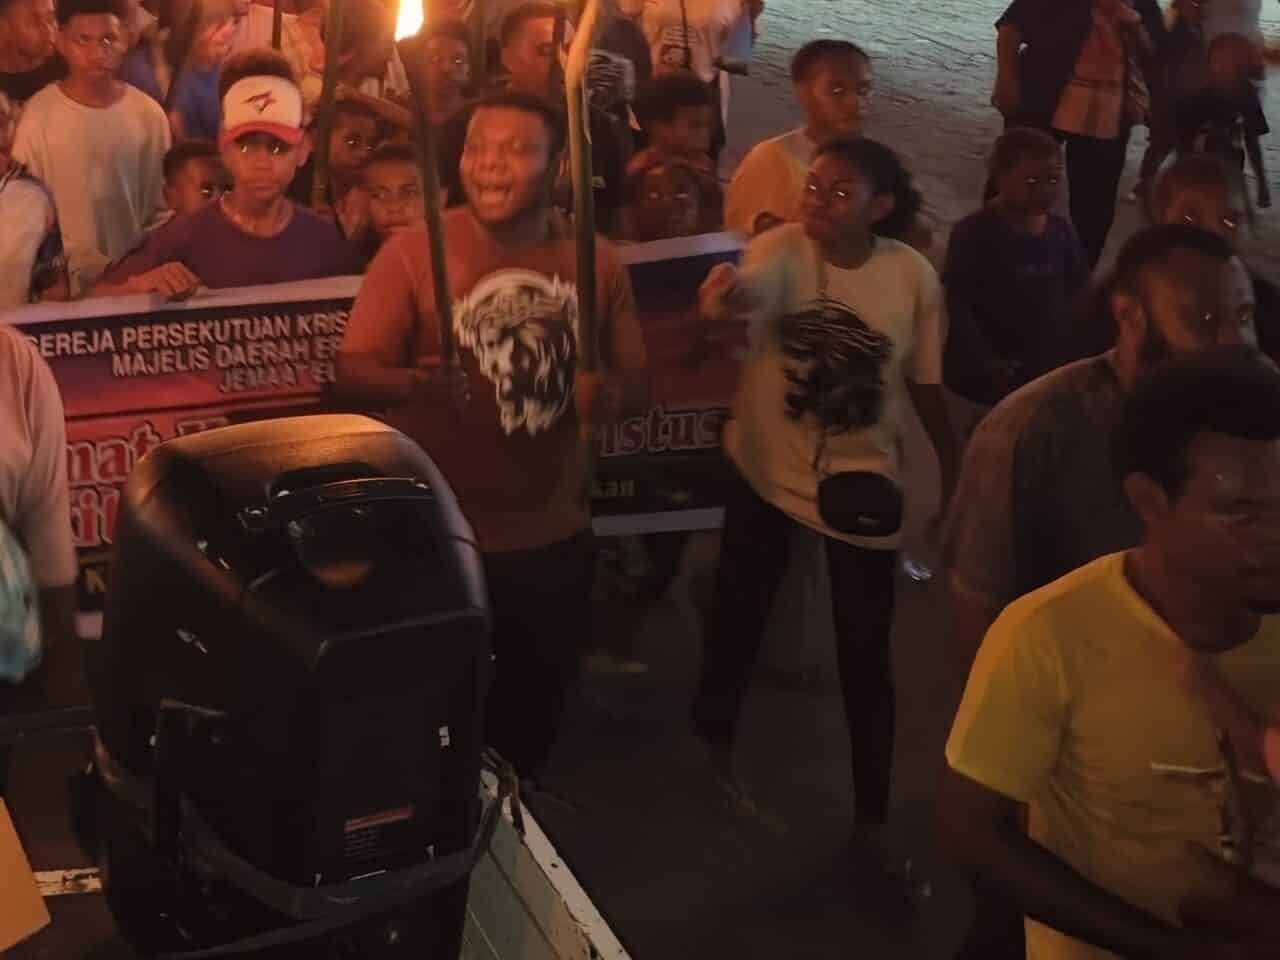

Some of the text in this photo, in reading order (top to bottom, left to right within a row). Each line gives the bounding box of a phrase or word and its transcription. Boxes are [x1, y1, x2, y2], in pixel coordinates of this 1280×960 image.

[121, 315, 288, 350] PERSEKUTUAN
[112, 346, 211, 378] MAJELIS
[215, 336, 310, 369] DAERAH
